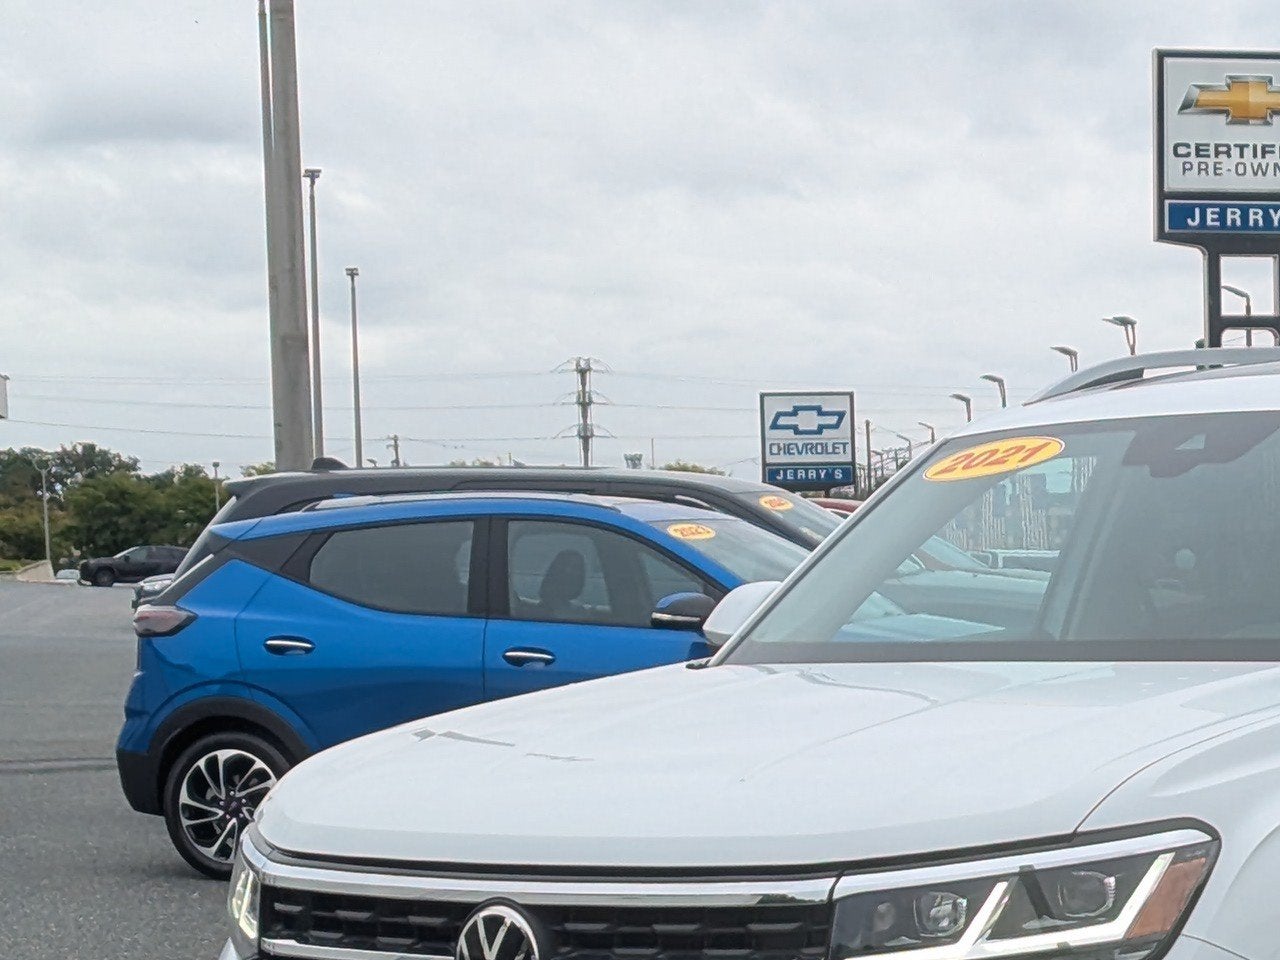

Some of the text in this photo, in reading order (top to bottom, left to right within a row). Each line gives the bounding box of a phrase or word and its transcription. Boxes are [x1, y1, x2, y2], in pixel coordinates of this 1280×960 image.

[769, 442, 850, 456] CHEVROLET
[931, 441, 1053, 477] 2021
[776, 468, 843, 480] JERRY'S
